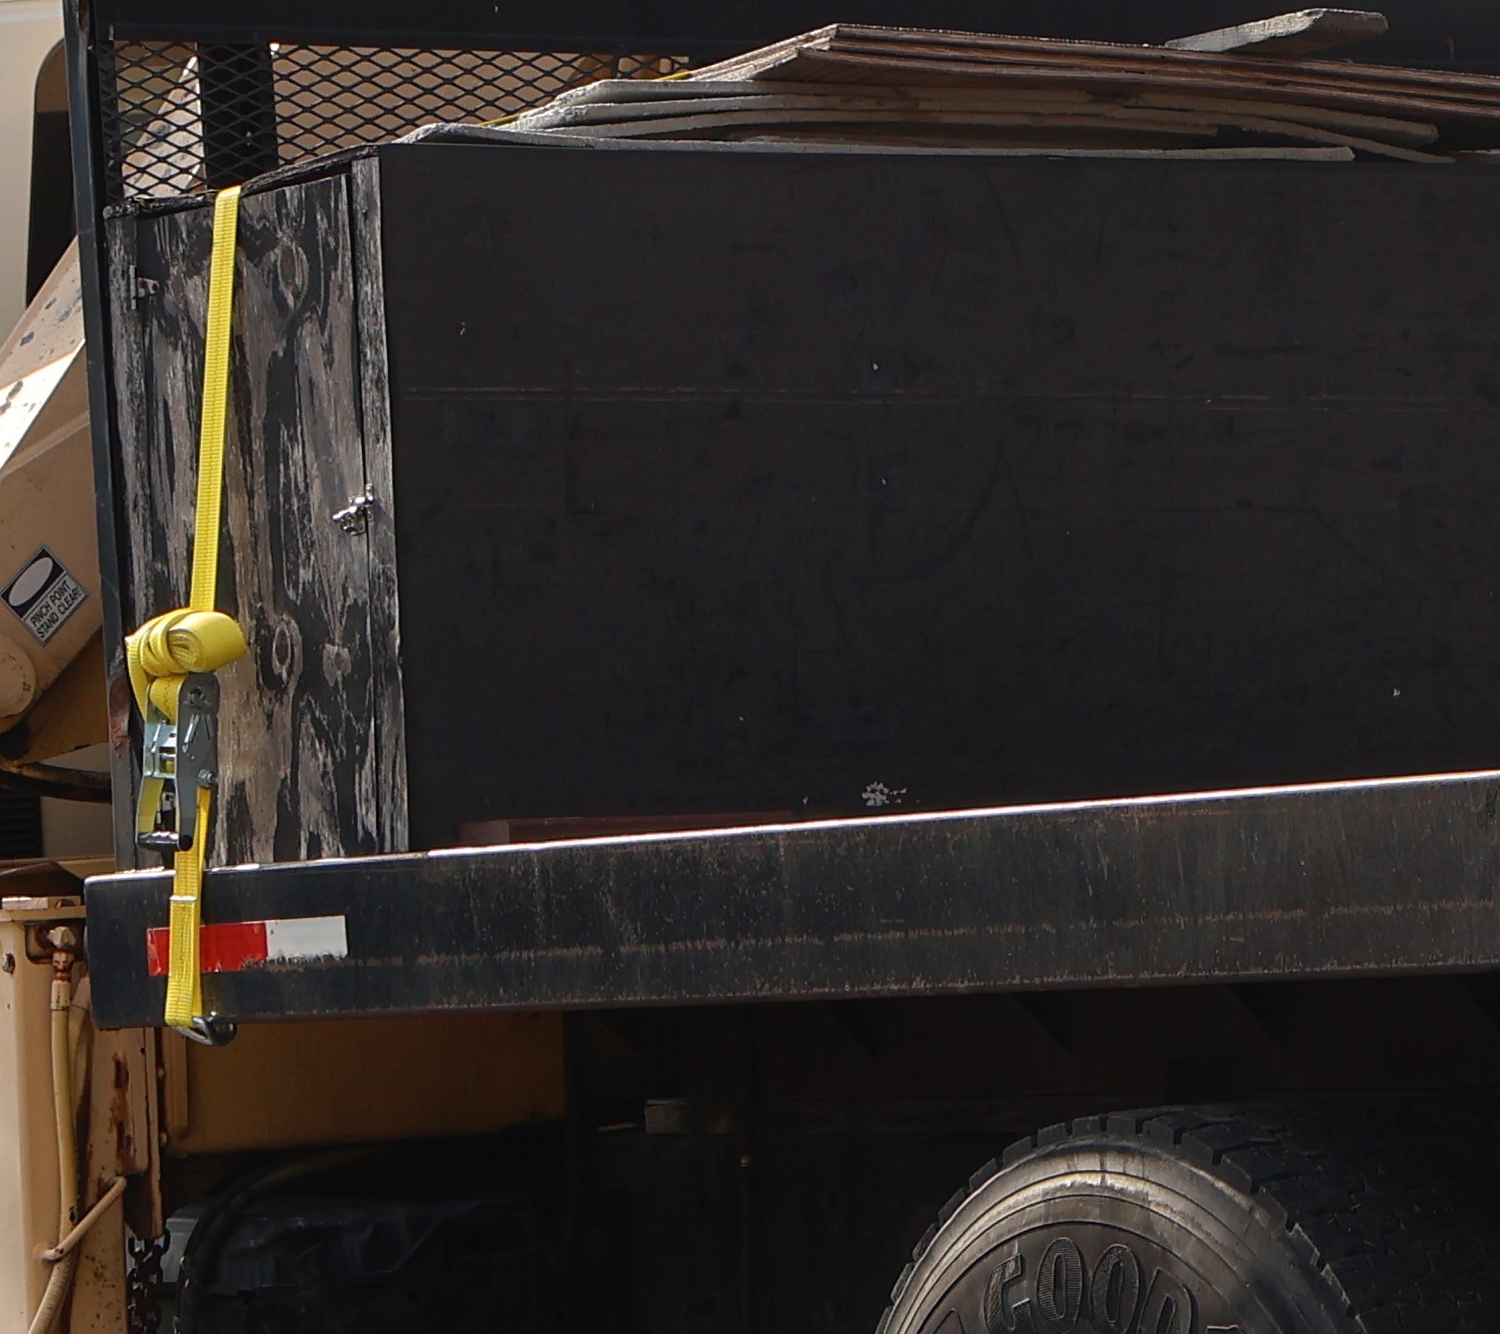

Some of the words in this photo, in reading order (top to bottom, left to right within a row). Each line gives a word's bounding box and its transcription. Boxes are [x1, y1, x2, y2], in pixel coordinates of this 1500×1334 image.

[30, 601, 53, 627] PINCH
[49, 579, 72, 606] POINT
[36, 612, 60, 639] STAND
